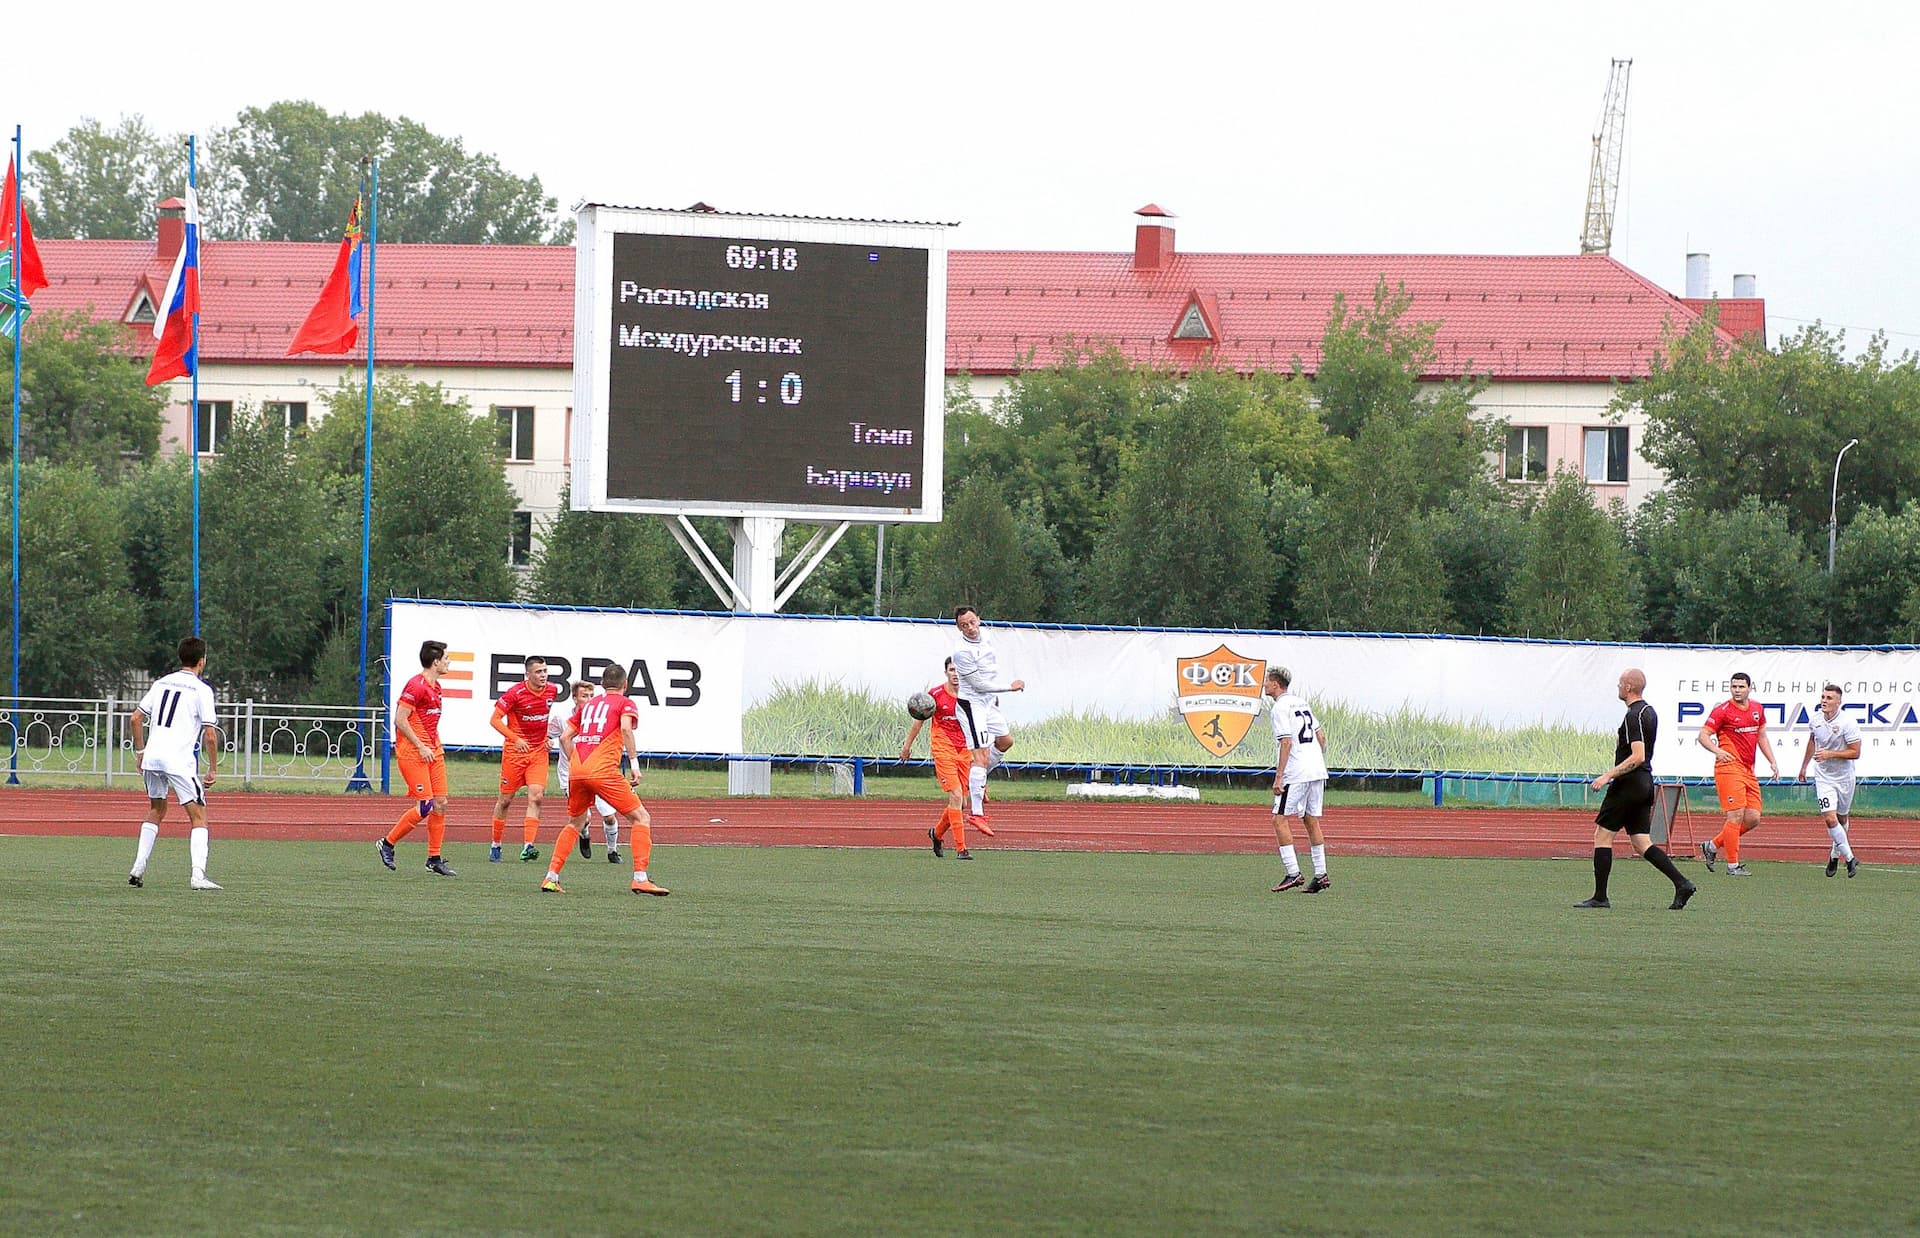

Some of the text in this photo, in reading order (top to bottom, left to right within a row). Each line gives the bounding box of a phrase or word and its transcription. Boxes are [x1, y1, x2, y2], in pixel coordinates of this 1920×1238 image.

[726, 245, 798, 271] 69:18
[1678, 680, 1832, 693] ГЕНЕАЛЬНЫЙ
[157, 689, 182, 729] 11
[581, 701, 610, 734] 44
